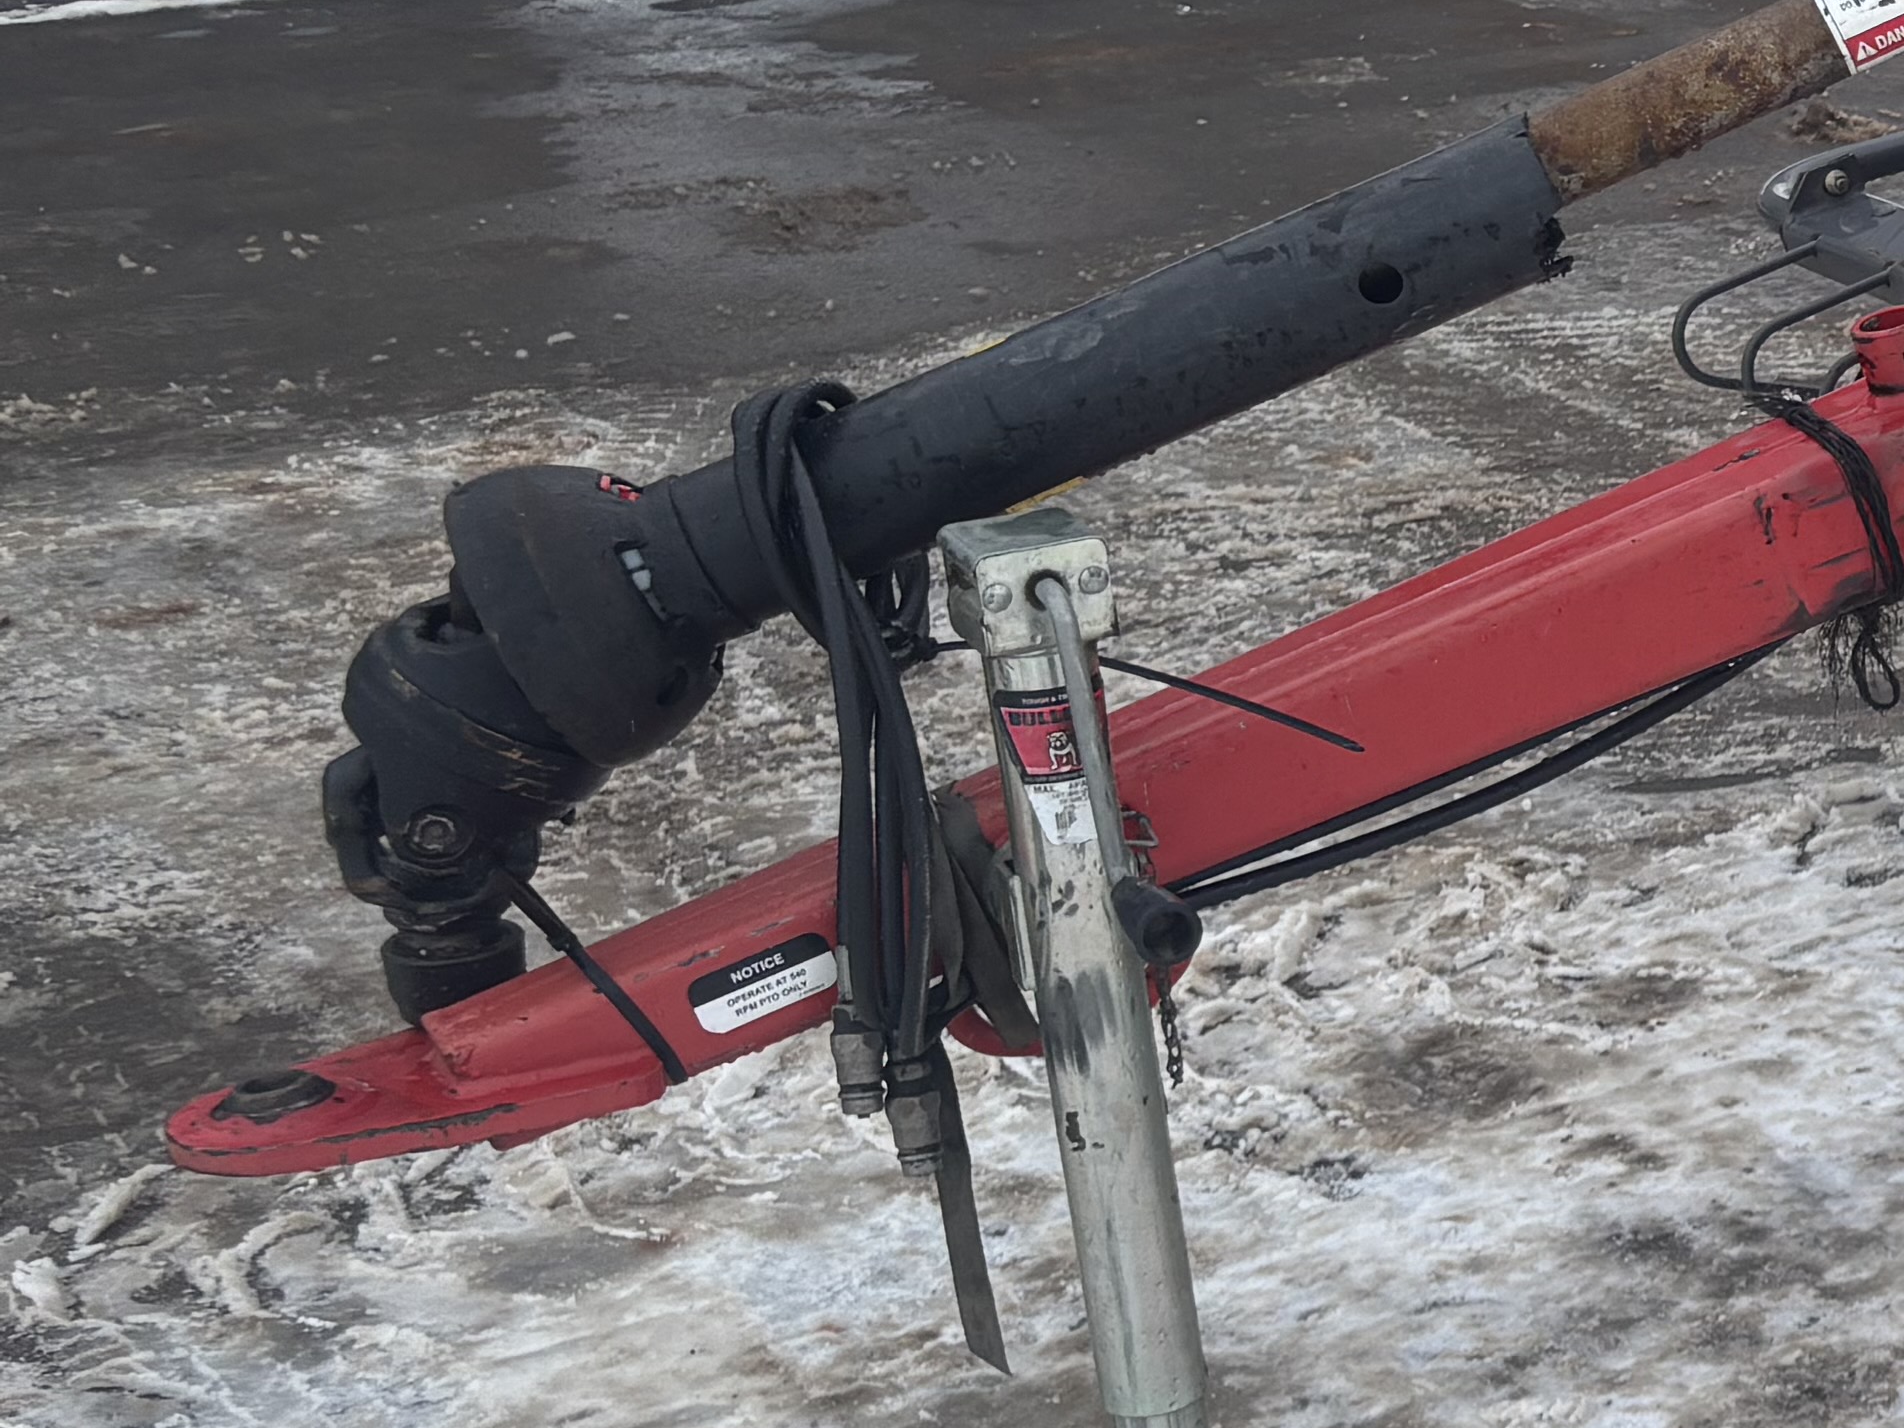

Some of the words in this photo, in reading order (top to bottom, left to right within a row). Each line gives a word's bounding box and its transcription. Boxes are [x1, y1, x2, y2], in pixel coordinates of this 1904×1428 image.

[730, 952, 785, 984] NOTICE
[726, 980, 775, 1009] OPERATE
[776, 977, 788, 988] AT
[735, 1002, 758, 1018] RPM
[759, 992, 781, 1009] PTO
[781, 979, 809, 998] ONLY
